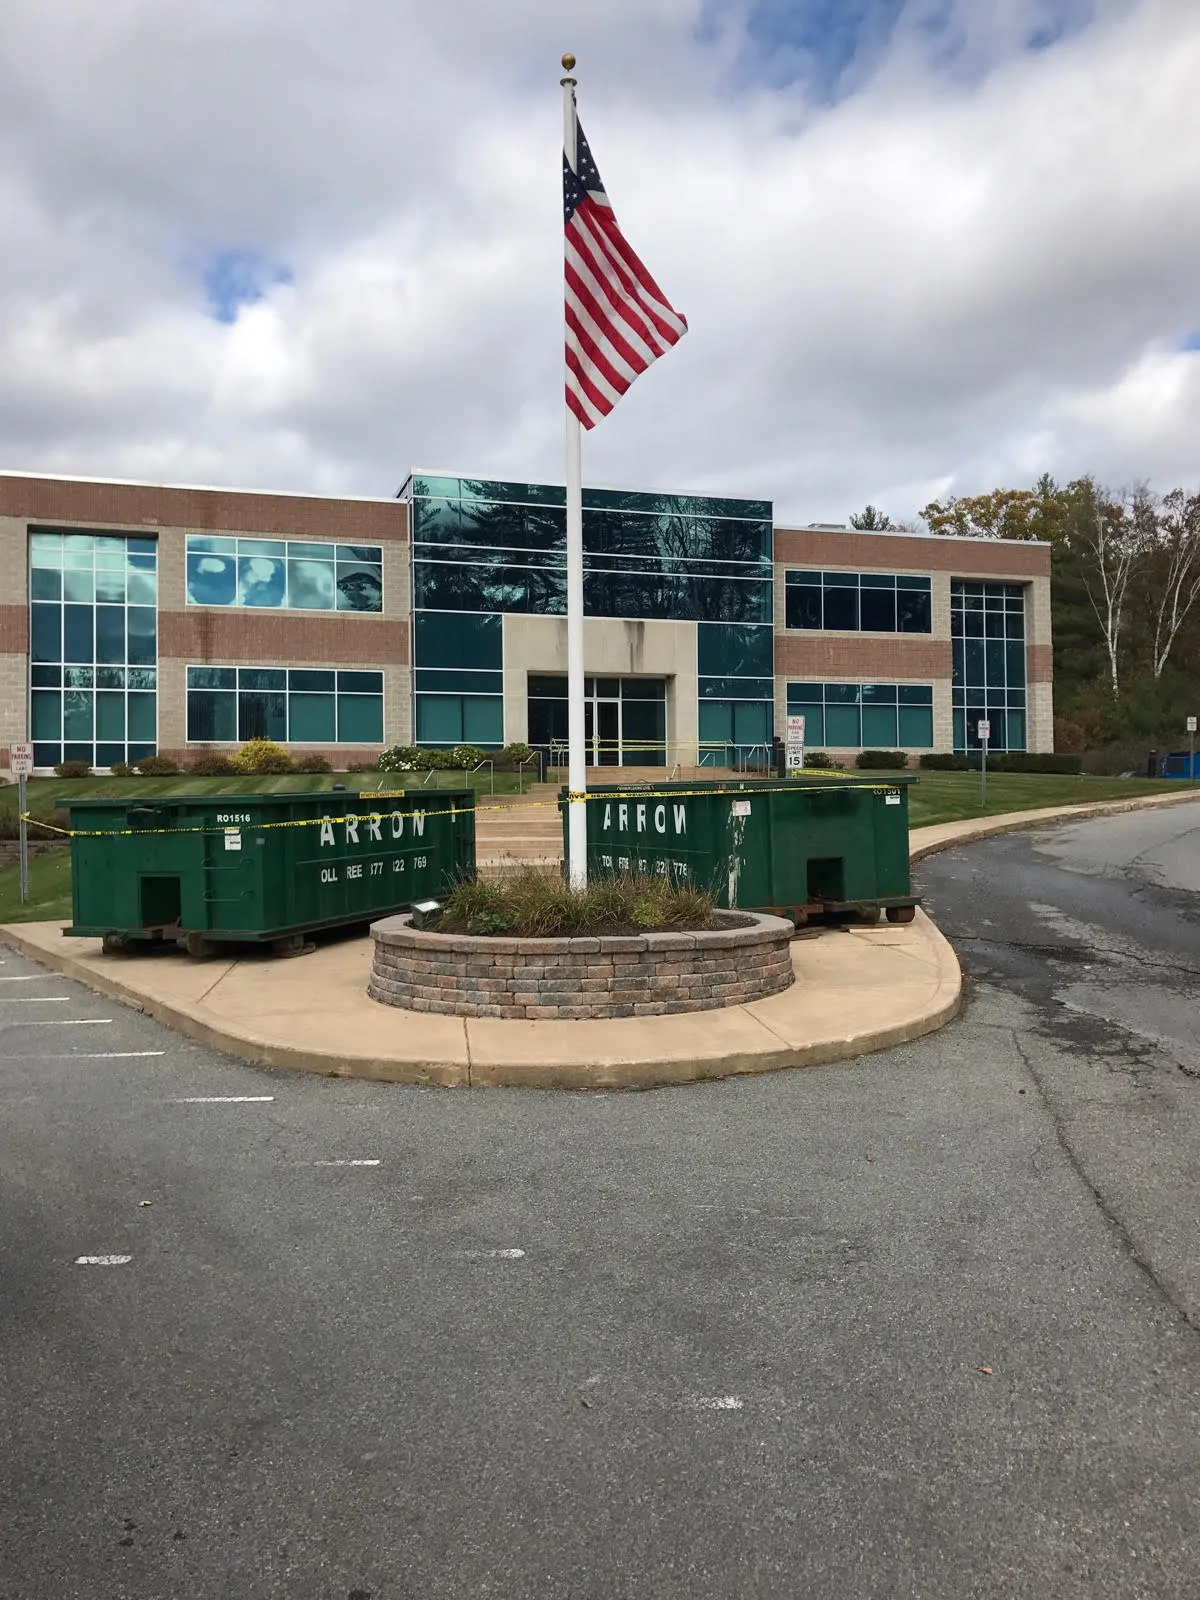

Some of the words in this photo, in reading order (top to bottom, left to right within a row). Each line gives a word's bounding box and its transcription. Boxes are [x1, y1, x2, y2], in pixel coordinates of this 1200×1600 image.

[789, 756, 800, 766] 15
[320, 808, 426, 847] ARROW
[603, 804, 686, 834] ARROW
[320, 868, 338, 883] OLL
[346, 864, 363, 880] REE
